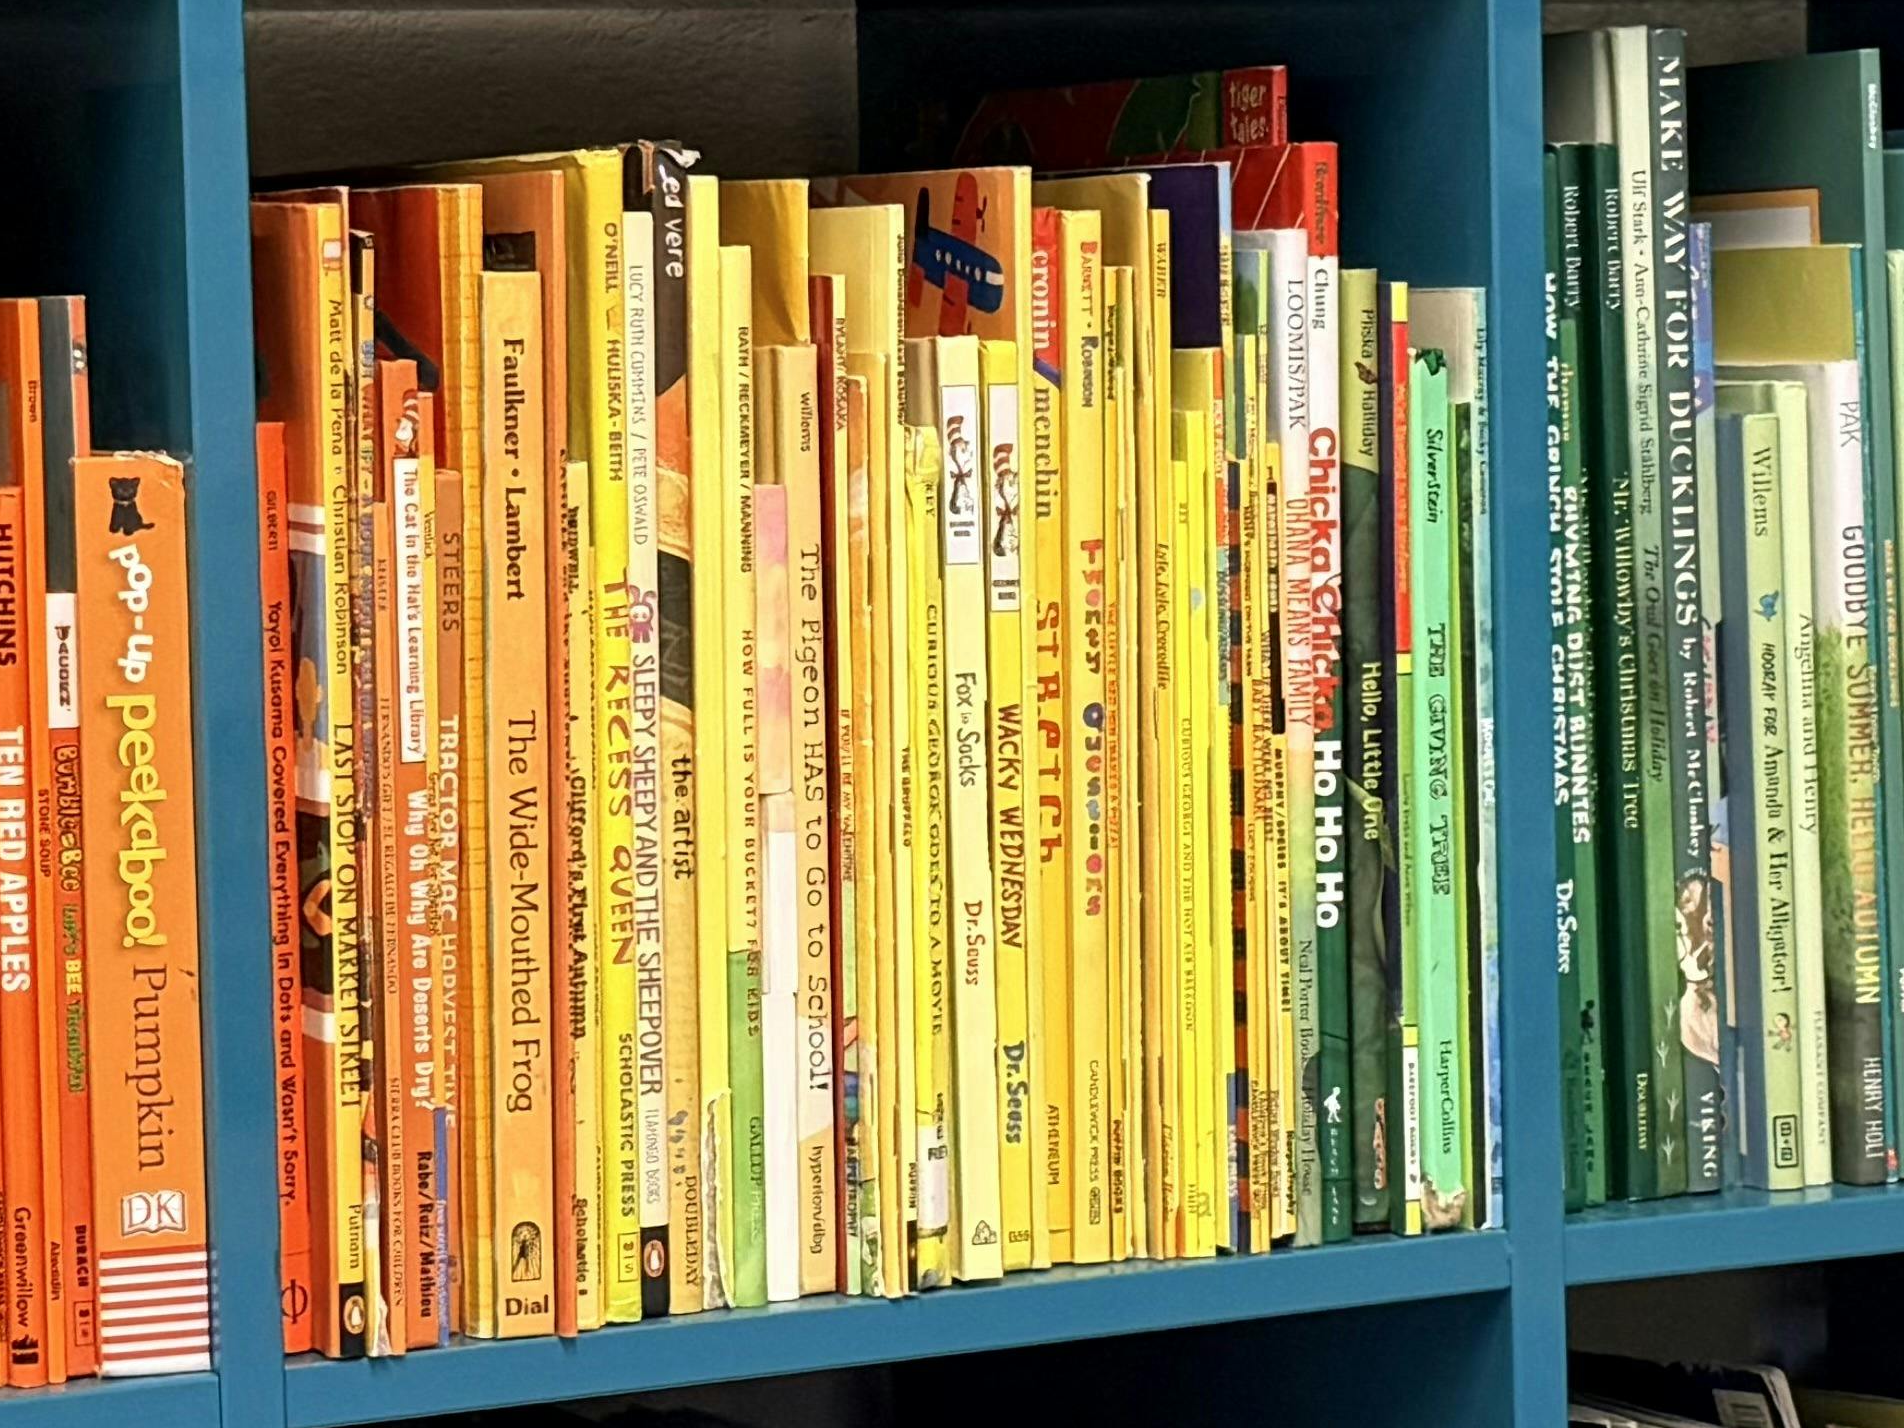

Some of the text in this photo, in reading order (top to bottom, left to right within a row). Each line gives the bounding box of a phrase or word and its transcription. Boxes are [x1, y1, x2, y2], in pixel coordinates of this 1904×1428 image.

[1658, 55, 1699, 628] MAKE WAY FOR DUCKLINGS
[499, 337, 530, 602] Faulkner Lambert
[1309, 427, 1339, 573] Chicka
[1423, 427, 1445, 524] Silverstein
[1749, 446, 1774, 538] Willems
[0, 871, 31, 993] APPLES
[104, 543, 172, 1173] pop-up peekaboo! Pumpkin
[504, 709, 545, 1116] The Wide-Mouthed Frog
[671, 754, 696, 882] the artist
[789, 542, 832, 1093] The Pigeon HAS to Go to School!
[996, 703, 1023, 949] WACKY WEDNESDAY
[1314, 739, 1343, 930] Ho Ho Ho
[1425, 622, 1456, 1156] THE GIVING TREE HarperCollins
[1760, 641, 1793, 995] HOORAY FOR Amanda & Her Alligator!
[406, 789, 437, 1111] Why Oh Why Are Deserts Dry?
[124, 1197, 184, 1232] DK
[504, 1296, 550, 1317] Dial
